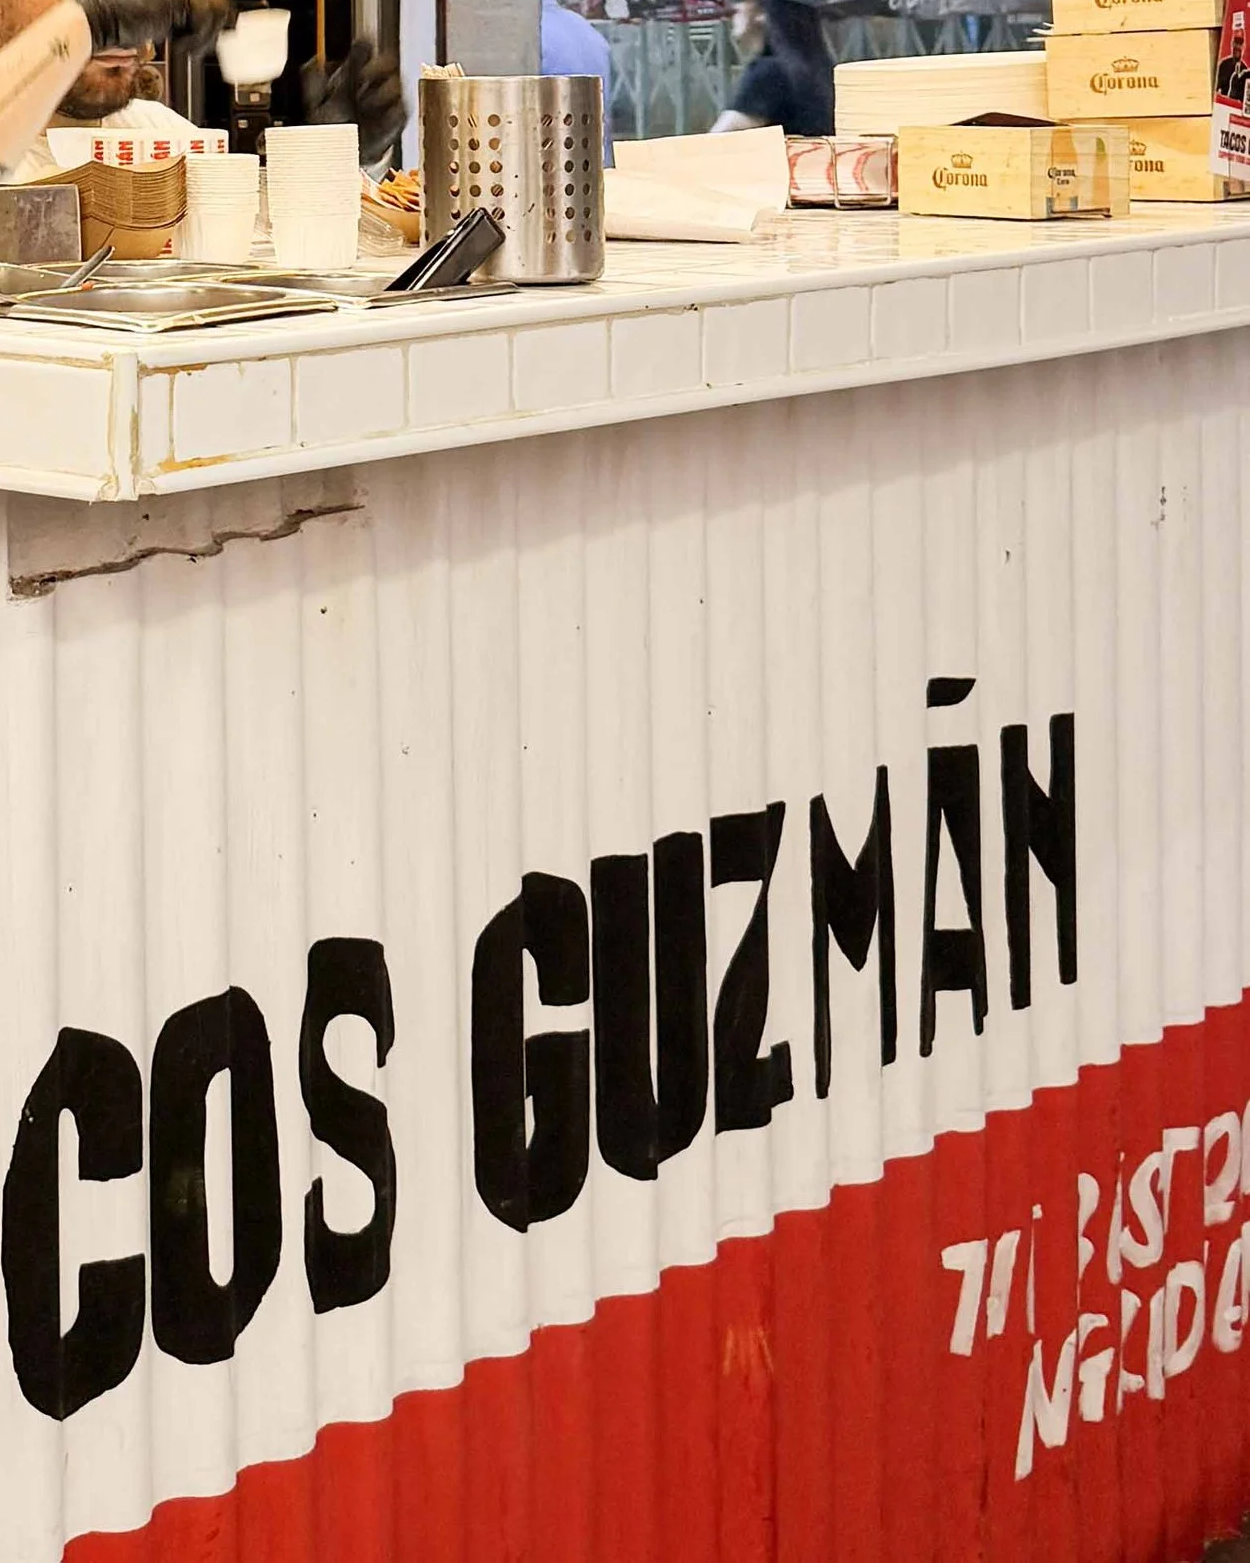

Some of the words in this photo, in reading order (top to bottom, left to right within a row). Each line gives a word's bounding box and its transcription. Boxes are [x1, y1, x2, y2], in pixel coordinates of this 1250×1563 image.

[1089, 72, 1160, 95] Corona
[932, 165, 988, 189] Corona
[470, 676, 1078, 1234] GUZMÁN
